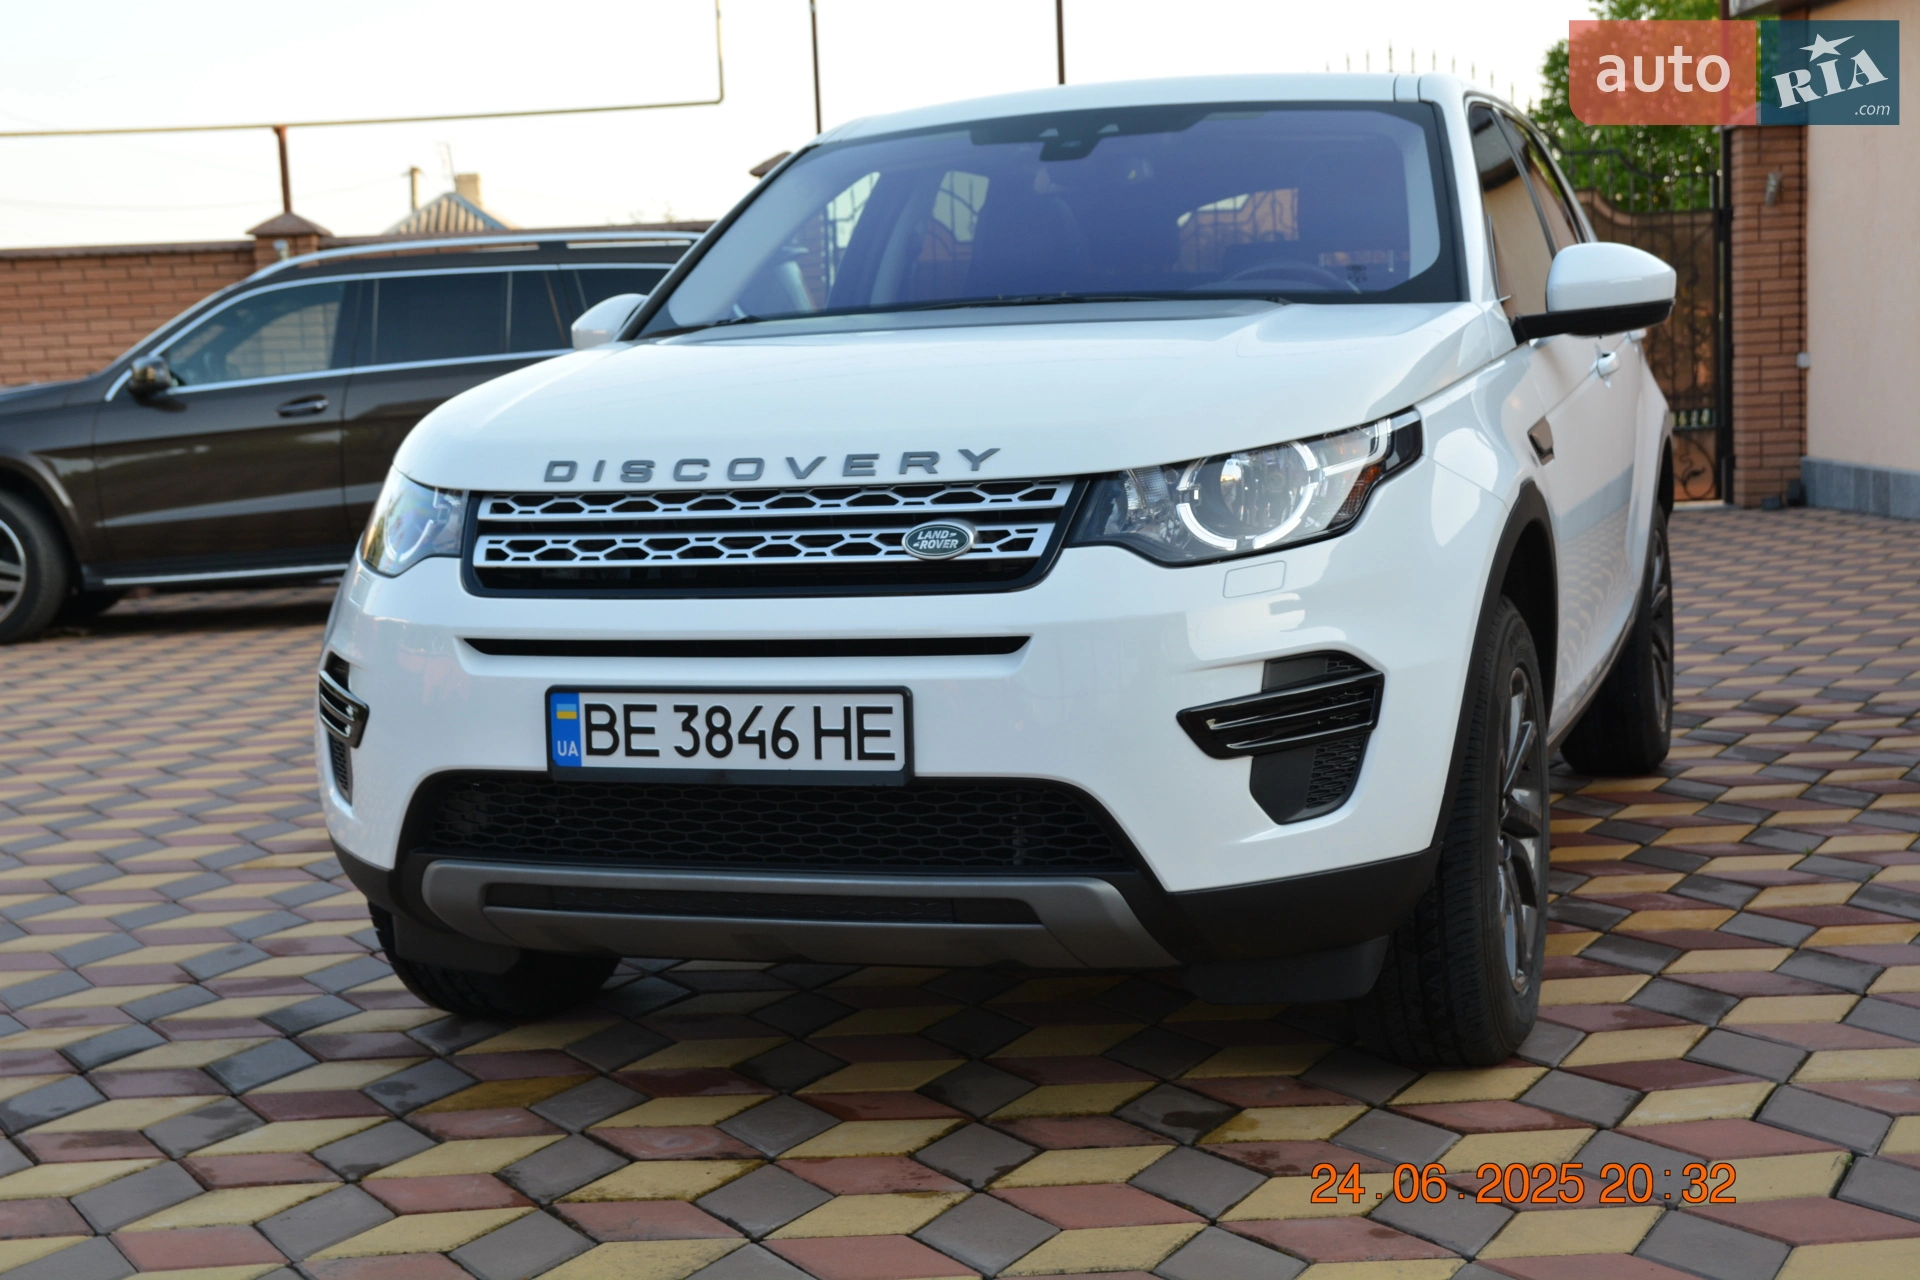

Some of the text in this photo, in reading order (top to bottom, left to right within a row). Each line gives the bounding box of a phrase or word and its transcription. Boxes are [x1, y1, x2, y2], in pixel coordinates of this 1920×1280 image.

[544, 447, 1001, 483] DISCOVERY
[557, 740, 579, 757] UA
[584, 703, 896, 761] BE 3846 HE
